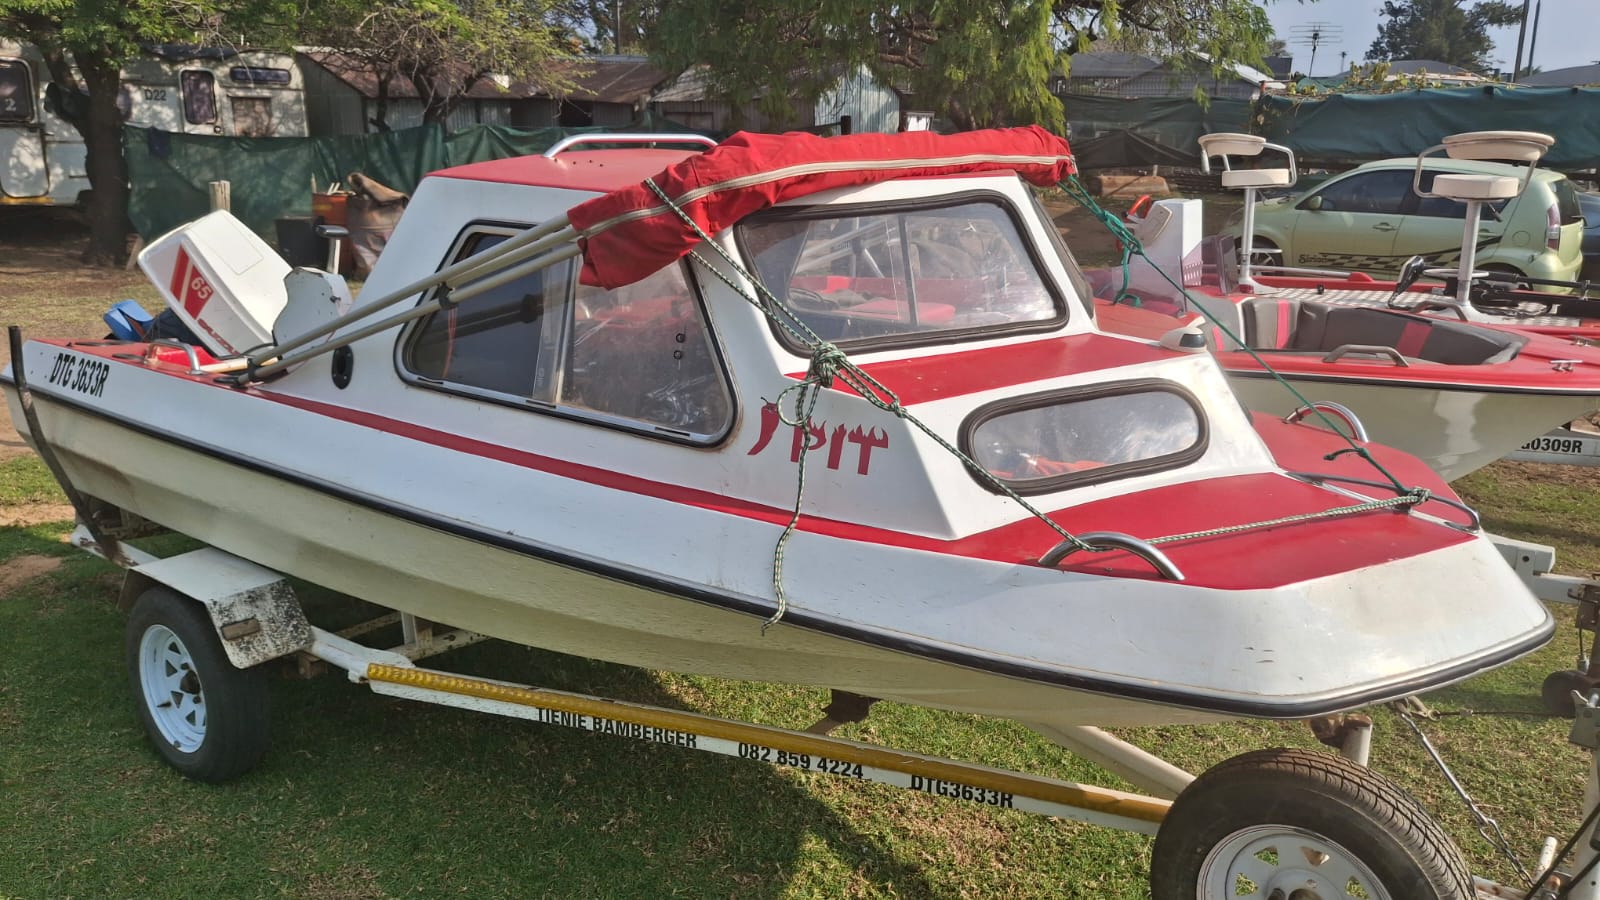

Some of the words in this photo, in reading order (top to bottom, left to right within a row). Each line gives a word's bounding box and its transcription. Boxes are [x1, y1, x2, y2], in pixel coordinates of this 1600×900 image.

[5, 98, 16, 112] 2
[144, 89, 166, 101] D22
[191, 276, 212, 299] 65
[49, 352, 77, 388] DTG
[71, 358, 110, 398] 3633R
[538, 707, 587, 729] TIENIE
[592, 716, 697, 749] BAMBERGER
[738, 742, 771, 762] 082
[777, 750, 811, 769] 859
[817, 757, 864, 779] 4224
[911, 774, 1014, 808] DTG3633R
